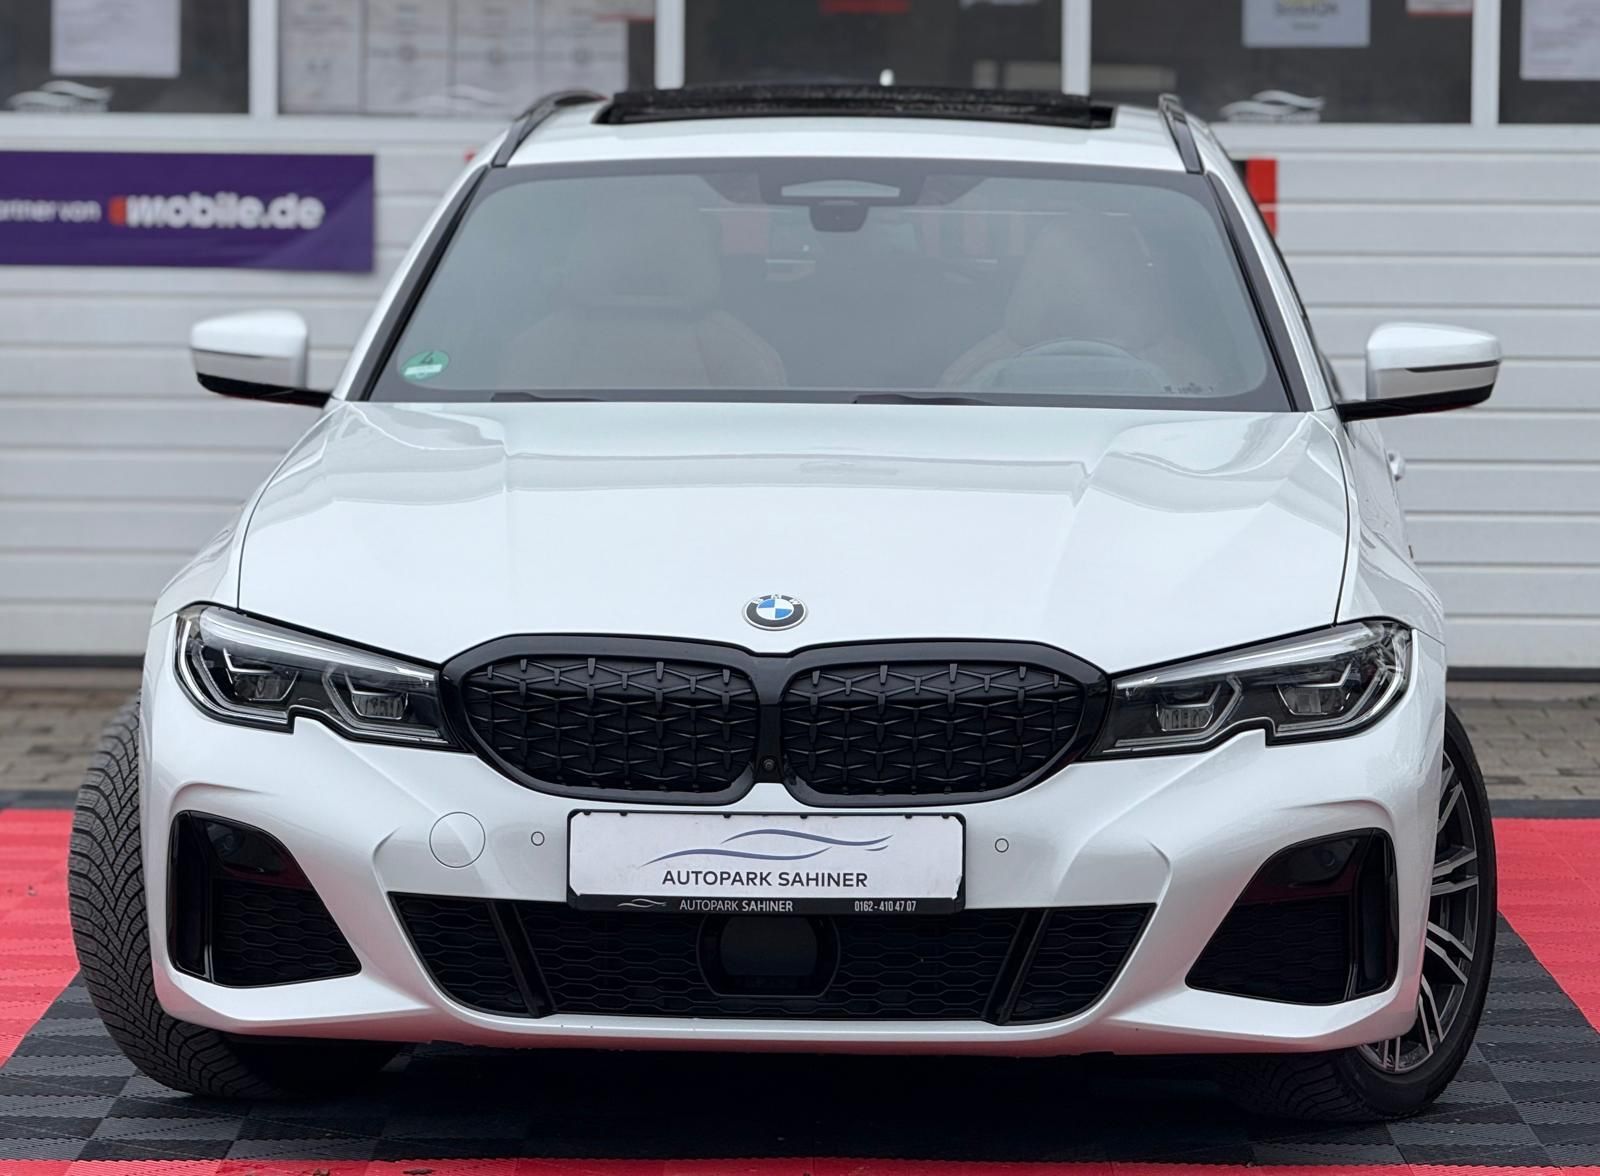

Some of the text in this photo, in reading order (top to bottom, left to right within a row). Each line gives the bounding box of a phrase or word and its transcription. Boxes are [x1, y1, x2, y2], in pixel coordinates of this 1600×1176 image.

[58, 201, 101, 222] von
[109, 191, 325, 229] mobile.de
[662, 870, 867, 888] AUTOPARK SAHINER
[679, 899, 793, 912] AUTOPARK SAHINER
